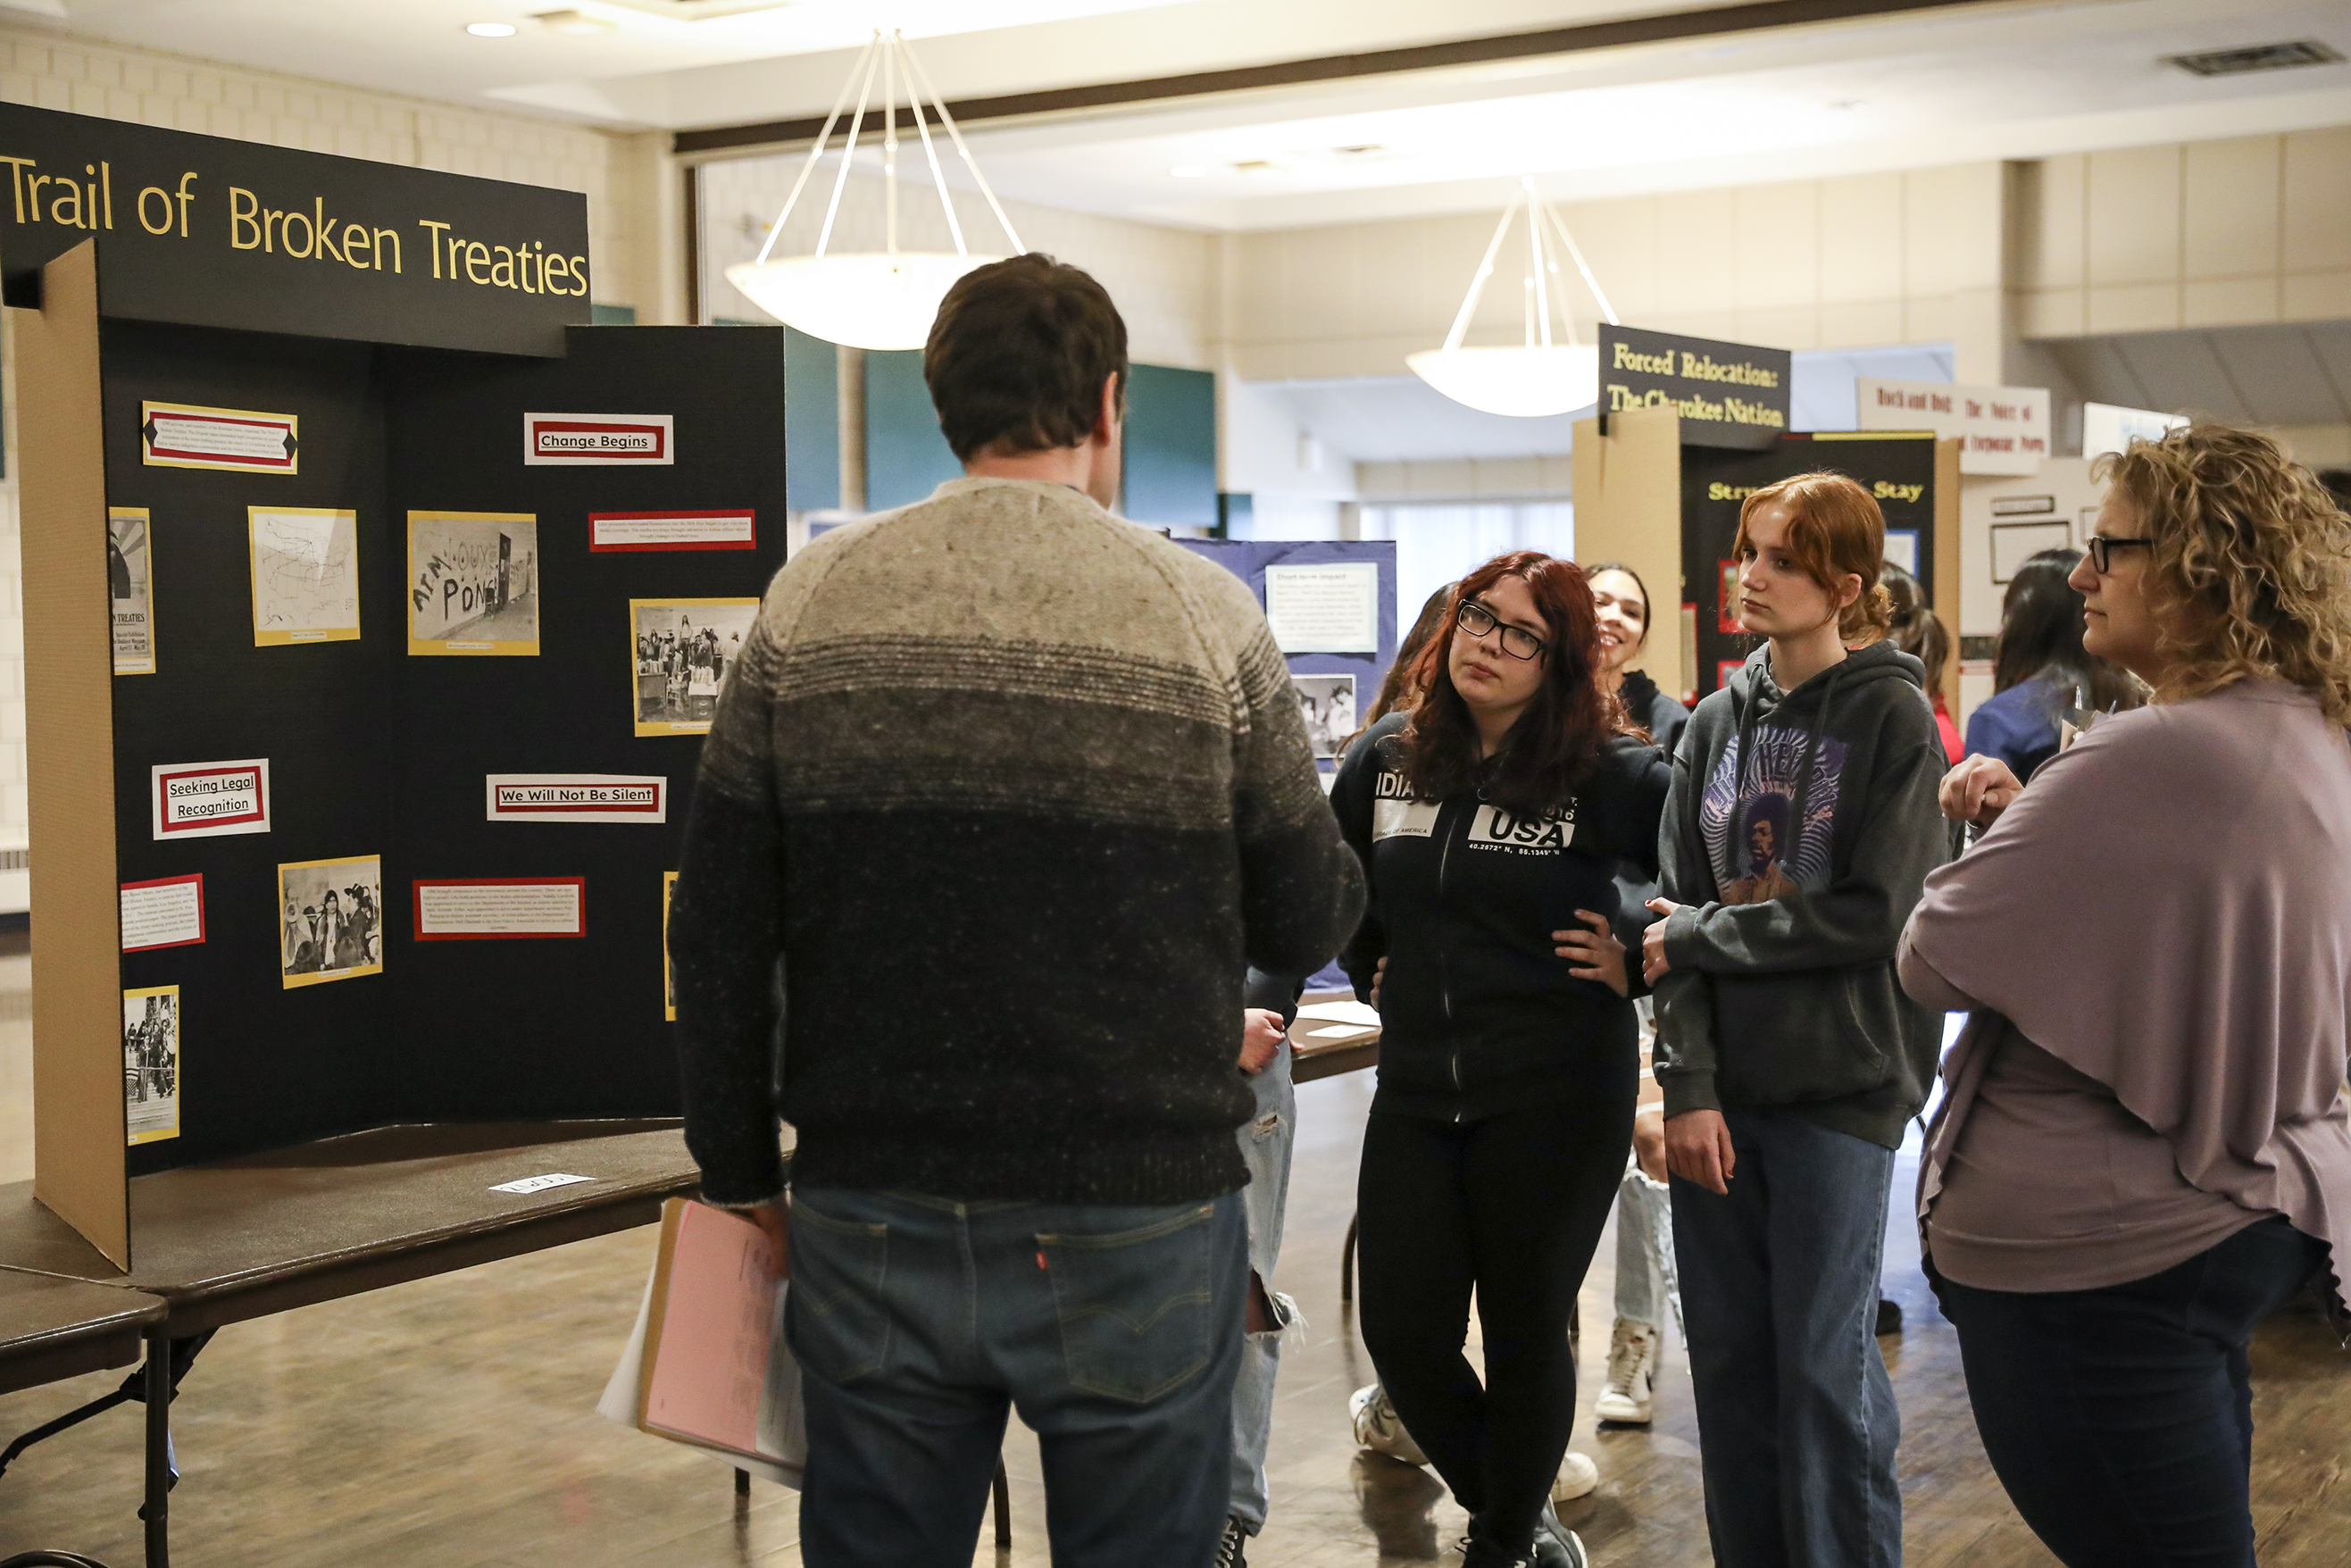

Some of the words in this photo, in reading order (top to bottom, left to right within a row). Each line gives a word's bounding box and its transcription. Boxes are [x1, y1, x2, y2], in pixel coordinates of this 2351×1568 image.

[0, 155, 113, 229] Trail
[137, 171, 197, 238] of
[229, 187, 402, 274] Broken
[419, 220, 588, 296] Treaties
[1613, 342, 1675, 376] Forced
[1680, 351, 1778, 388] Relocation:
[1607, 384, 1643, 412] The
[1645, 388, 1724, 421] Chrokee
[1724, 396, 1784, 428] Nation
[541, 435, 596, 449] Change
[601, 435, 648, 449] Begins
[1874, 480, 1924, 503] Stay
[170, 780, 217, 797] Seeking
[222, 775, 254, 791] Legal
[501, 790, 523, 801] We
[528, 789, 554, 801] Will
[560, 789, 585, 801] Not
[590, 789, 607, 800] Be
[613, 788, 652, 800] Silent
[178, 797, 248, 816] Recognition
[1489, 808, 1563, 848] USA
